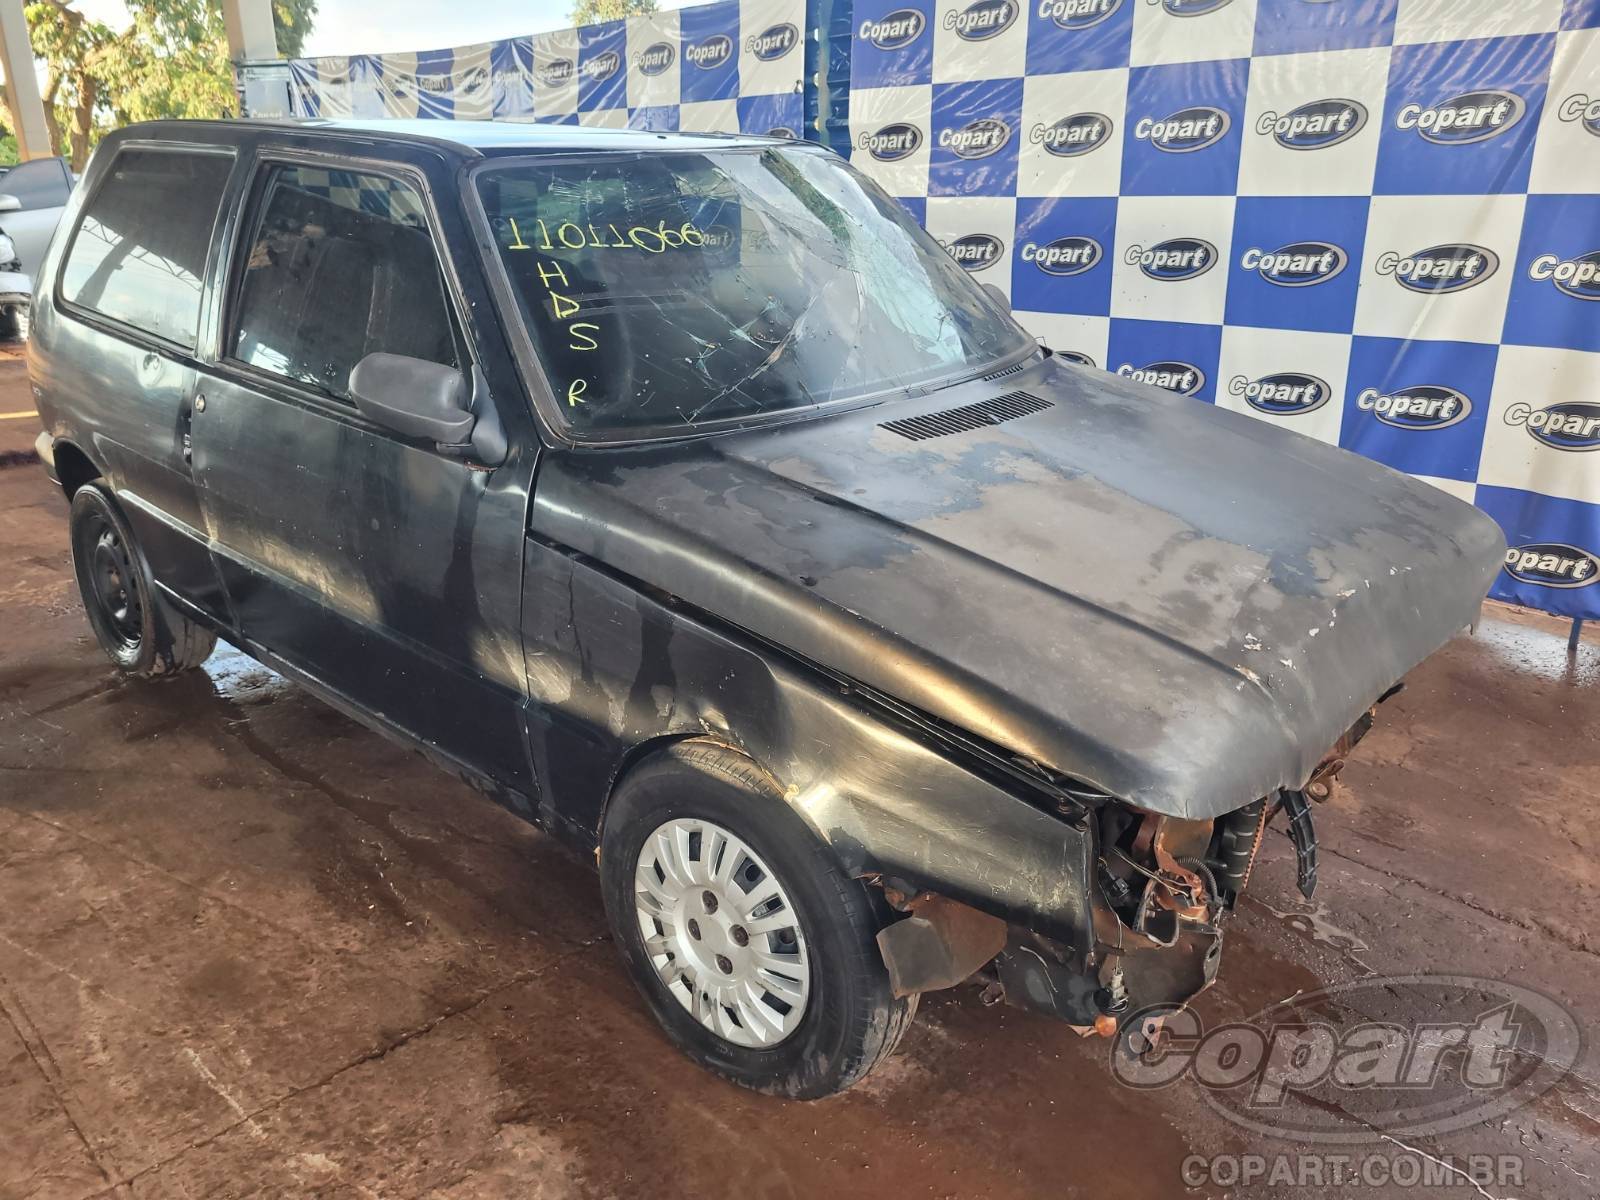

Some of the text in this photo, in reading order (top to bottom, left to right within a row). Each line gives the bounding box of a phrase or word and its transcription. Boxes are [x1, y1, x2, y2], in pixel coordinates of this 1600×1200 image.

[859, 16, 917, 41] Copart
[943, 5, 1010, 32] Copart
[686, 41, 727, 63] Copart
[745, 31, 790, 55] Copart
[632, 47, 670, 68] Copart
[1135, 113, 1219, 143] Copart
[1256, 107, 1351, 139] Copart
[1396, 97, 1511, 135] Copart
[858, 131, 914, 154] Copart
[939, 128, 1000, 149] Copart
[1030, 121, 1101, 148] Copart
[936, 240, 994, 261] opart
[1022, 241, 1094, 264] Copart
[1125, 243, 1207, 271] Copart
[1241, 247, 1336, 275] Copart
[1375, 249, 1480, 280] Copart
[1528, 253, 1600, 288] Cop
[569, 322, 600, 351] S
[568, 378, 588, 407] R
[1229, 375, 1318, 404] Copart
[1357, 389, 1457, 420] Copart
[1503, 402, 1600, 437] Copar
[1504, 548, 1591, 581] opart
